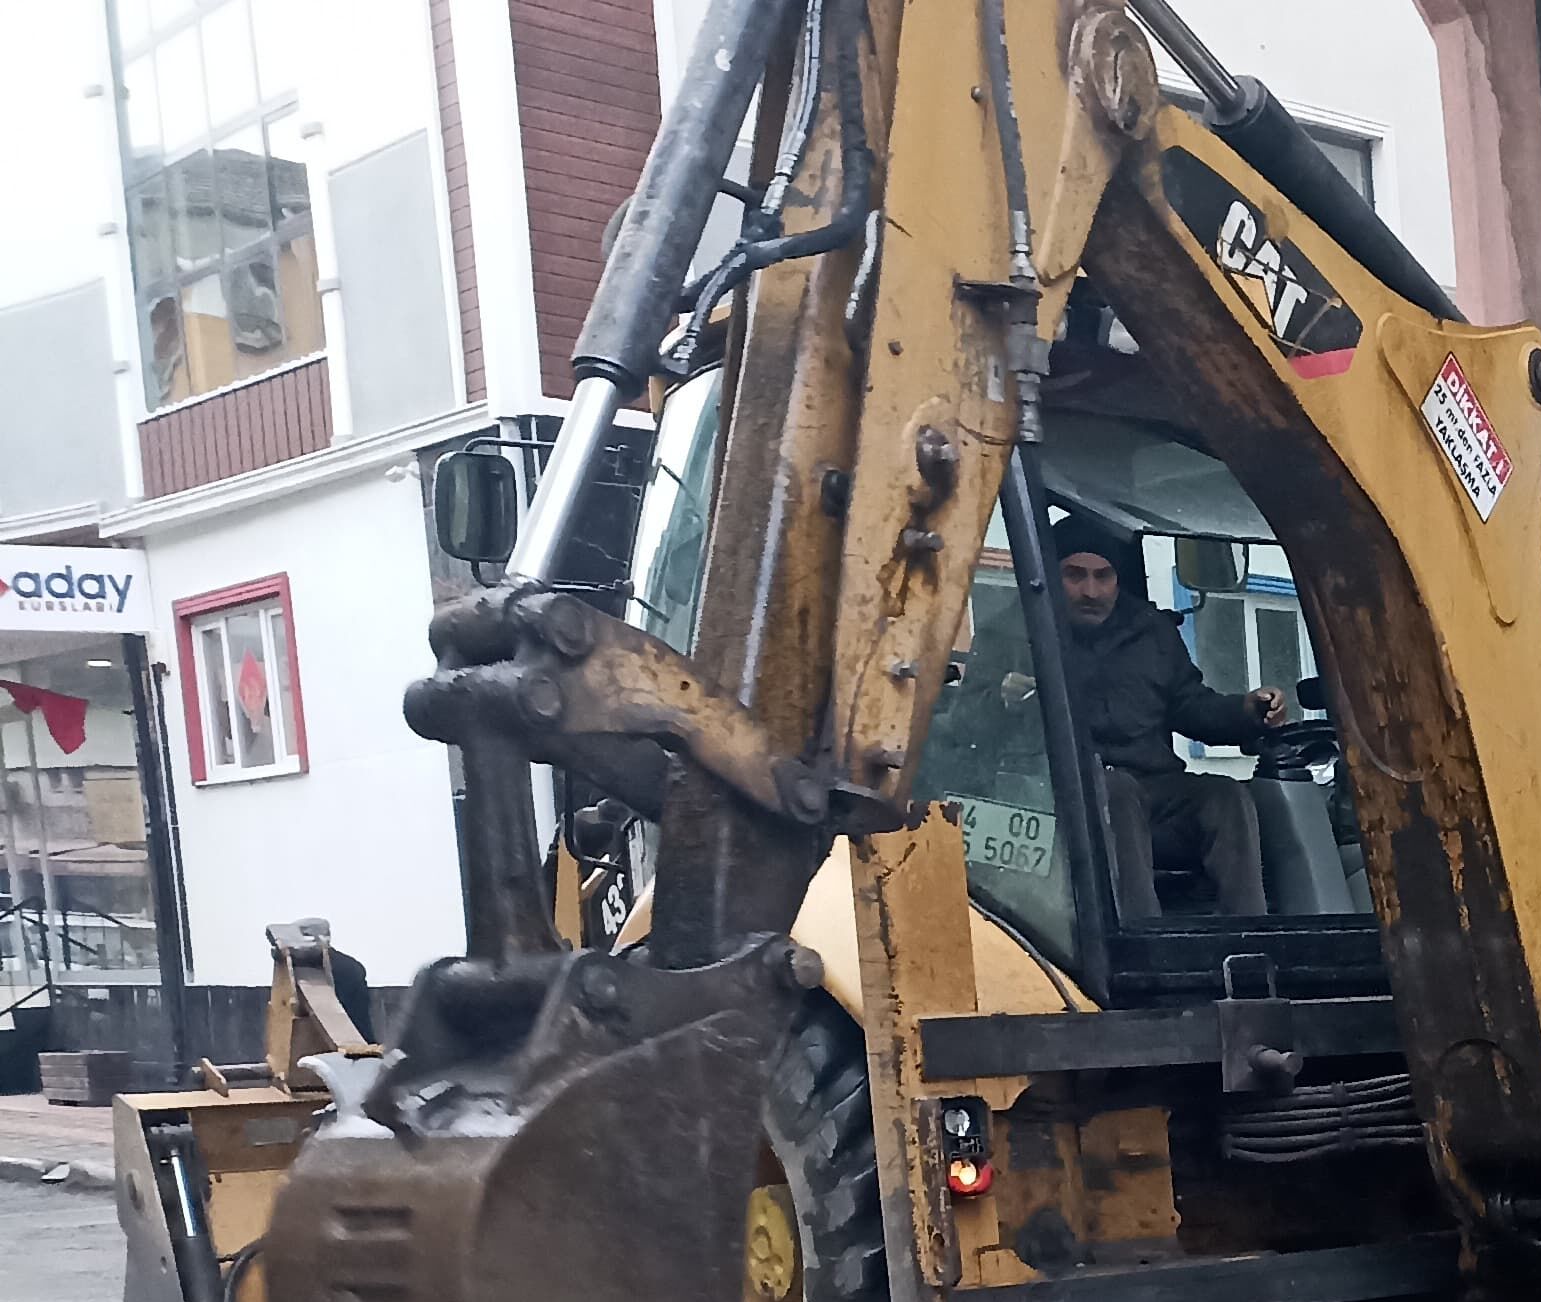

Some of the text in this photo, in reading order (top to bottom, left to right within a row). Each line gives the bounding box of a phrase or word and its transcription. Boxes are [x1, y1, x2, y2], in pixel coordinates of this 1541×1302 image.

[1216, 200, 1307, 338] CAT
[1446, 371, 1497, 458] DİKKAT
[1435, 416, 1481, 498] YAKLAŞMA
[12, 565, 133, 613] aday
[984, 837, 1046, 868] 5067
[1009, 813, 1040, 840] 00
